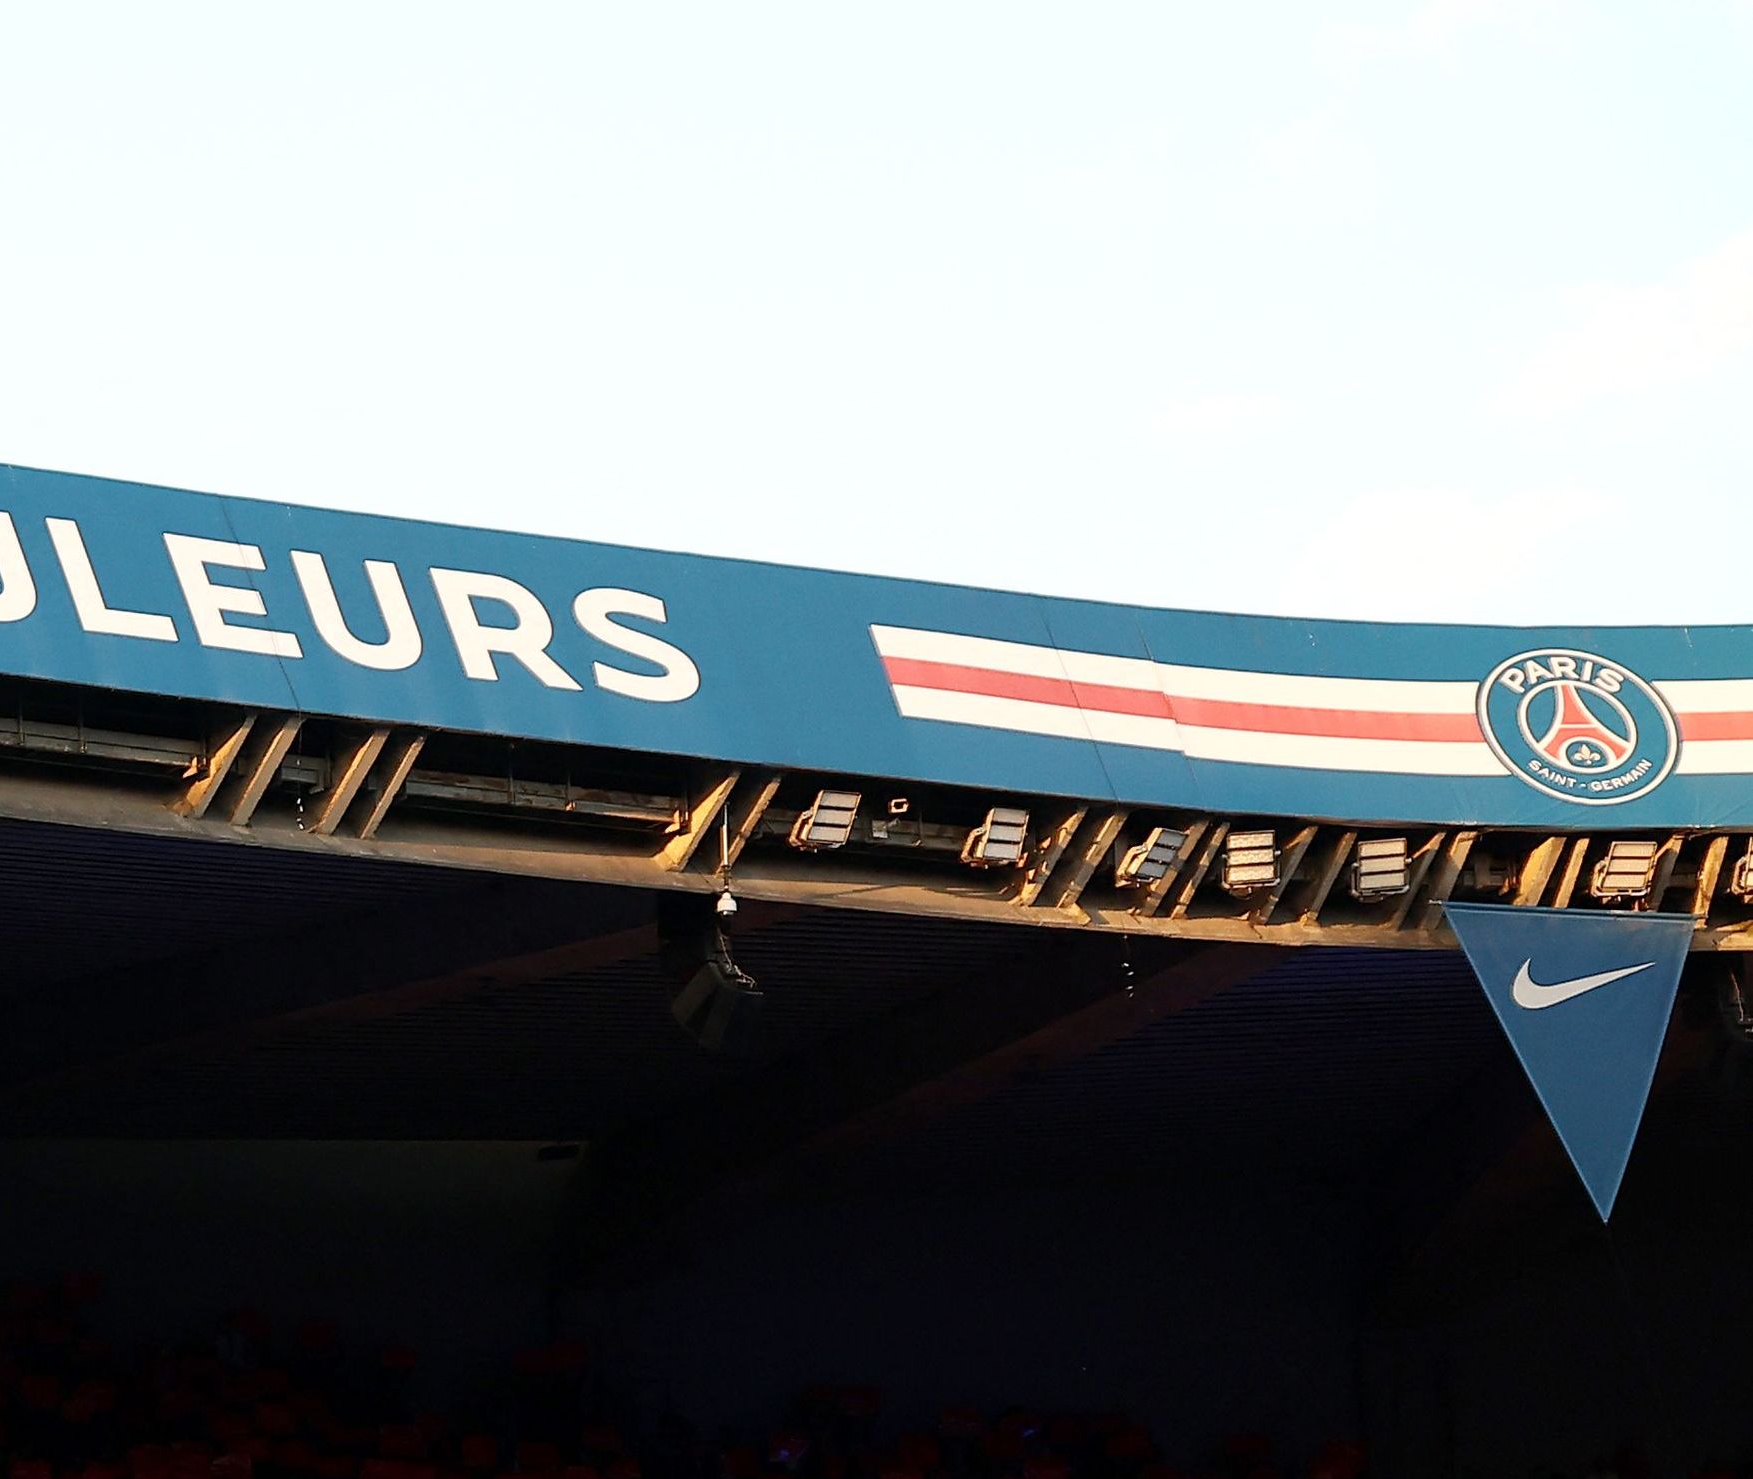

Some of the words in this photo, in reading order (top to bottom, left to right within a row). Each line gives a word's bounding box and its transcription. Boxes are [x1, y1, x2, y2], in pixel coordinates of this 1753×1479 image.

[1498, 656, 1625, 694] PARIS
[1528, 759, 1577, 788] SAINT
[1590, 759, 1653, 792] GERMAIN
